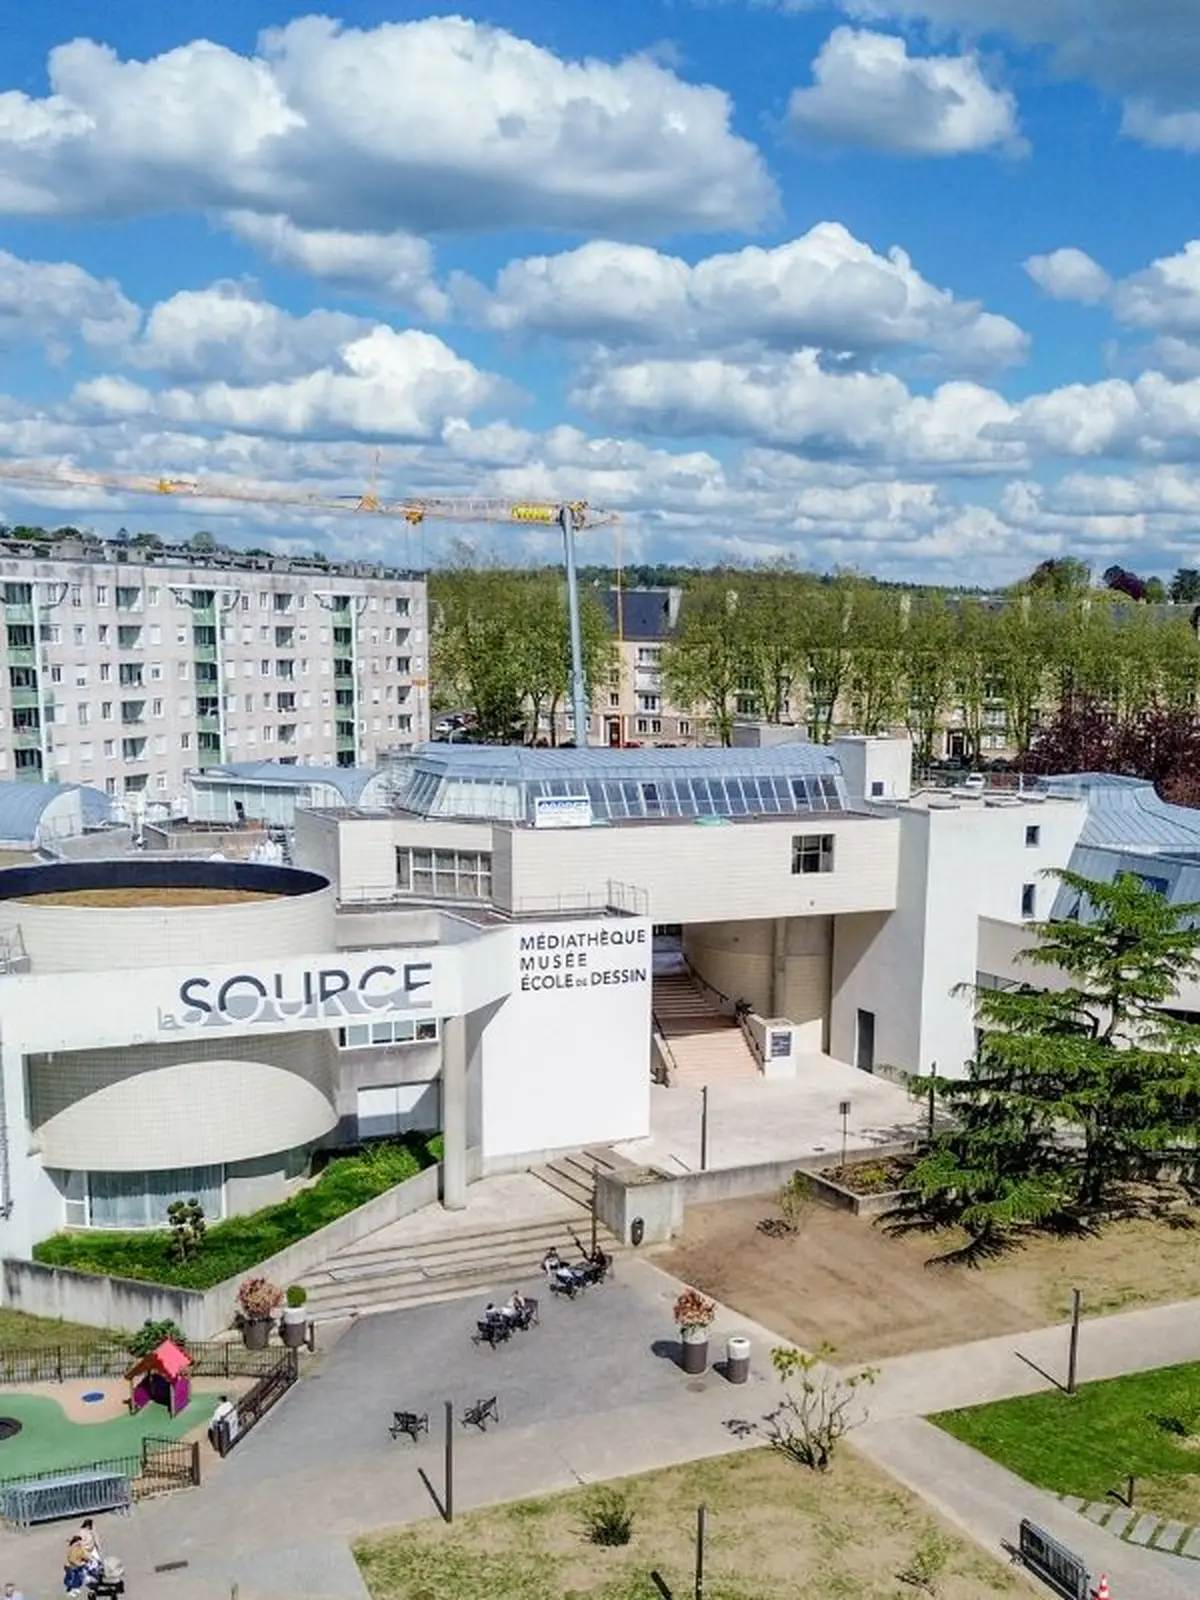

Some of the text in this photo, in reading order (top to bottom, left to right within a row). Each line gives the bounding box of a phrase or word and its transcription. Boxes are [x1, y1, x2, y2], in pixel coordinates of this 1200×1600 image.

[520, 929, 646, 951] MÉDIATHÈQUE
[520, 951, 588, 971] MUSÉE
[521, 968, 647, 991] ÉCOLE DE DESSIN
[157, 963, 433, 1031] la SOURCE
